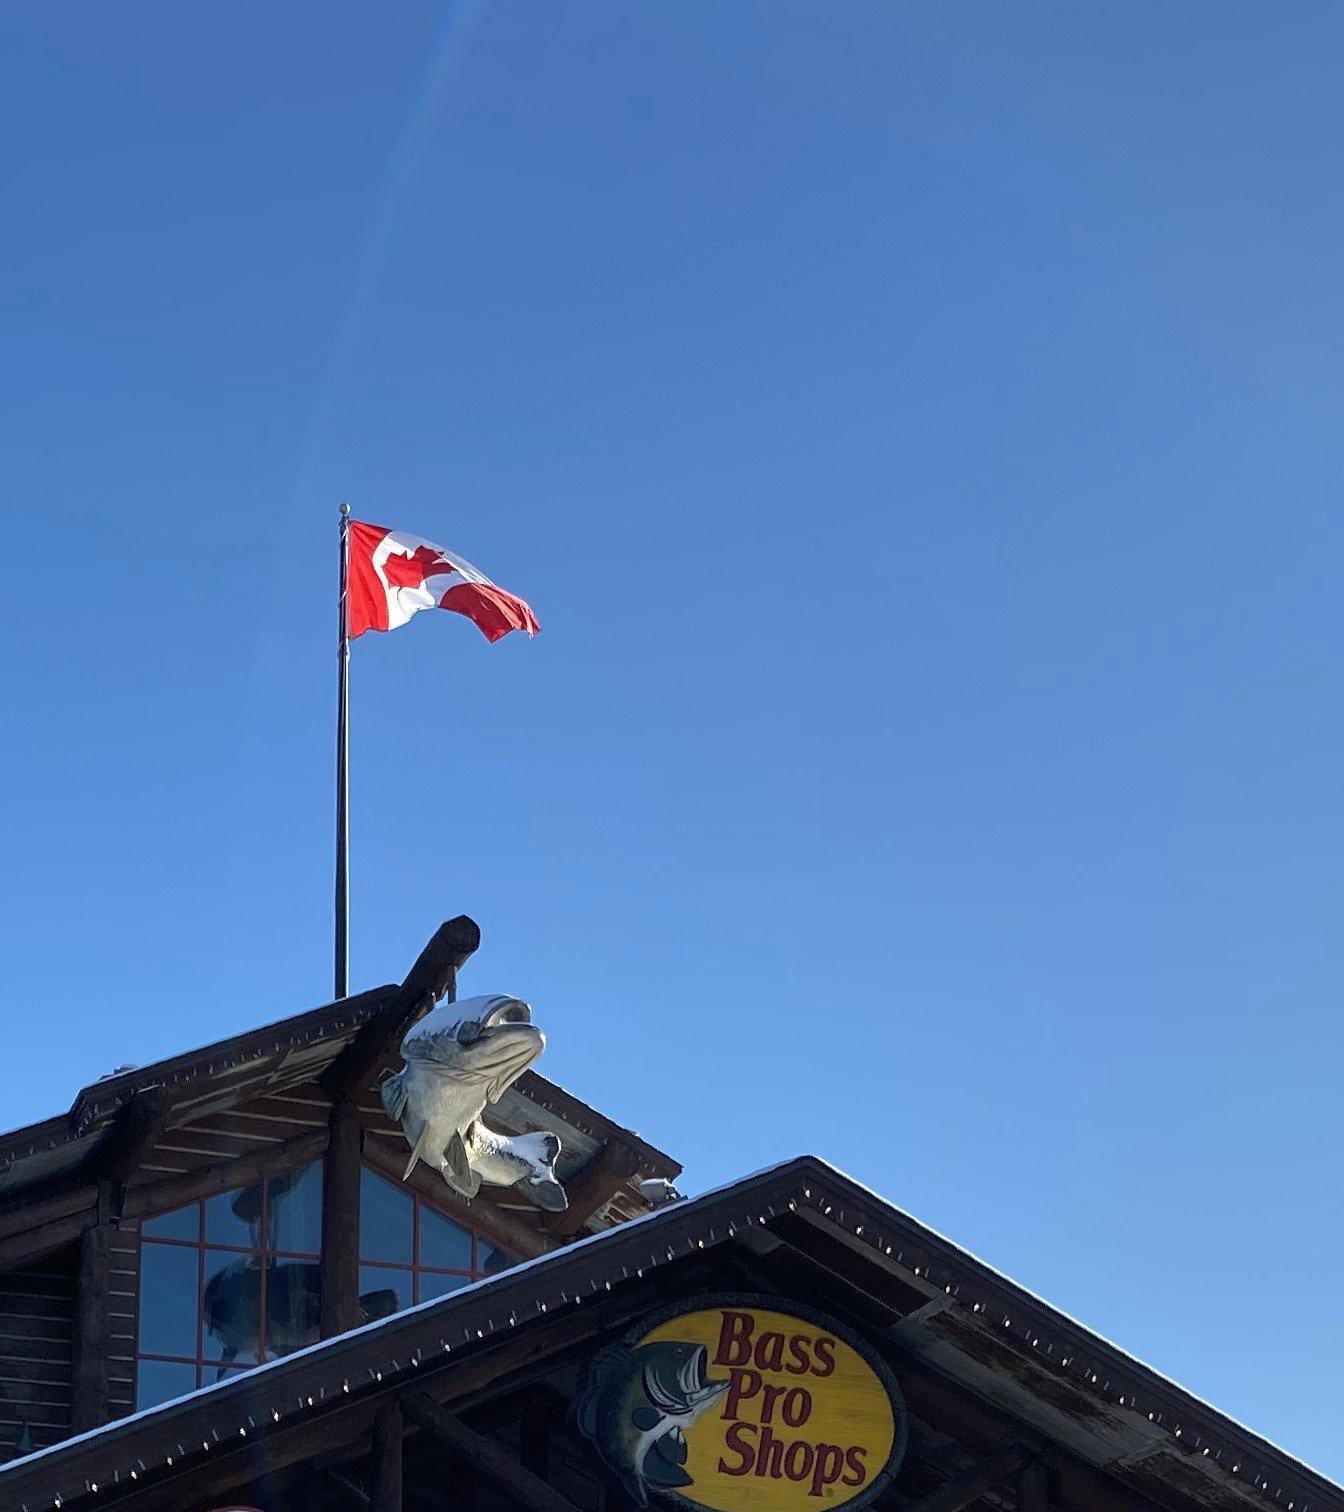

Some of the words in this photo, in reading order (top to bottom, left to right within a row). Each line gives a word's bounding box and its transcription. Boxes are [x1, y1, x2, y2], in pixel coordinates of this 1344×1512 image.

[711, 1311, 836, 1378] Bass
[719, 1368, 813, 1429] Pro
[717, 1422, 868, 1497] Shops
